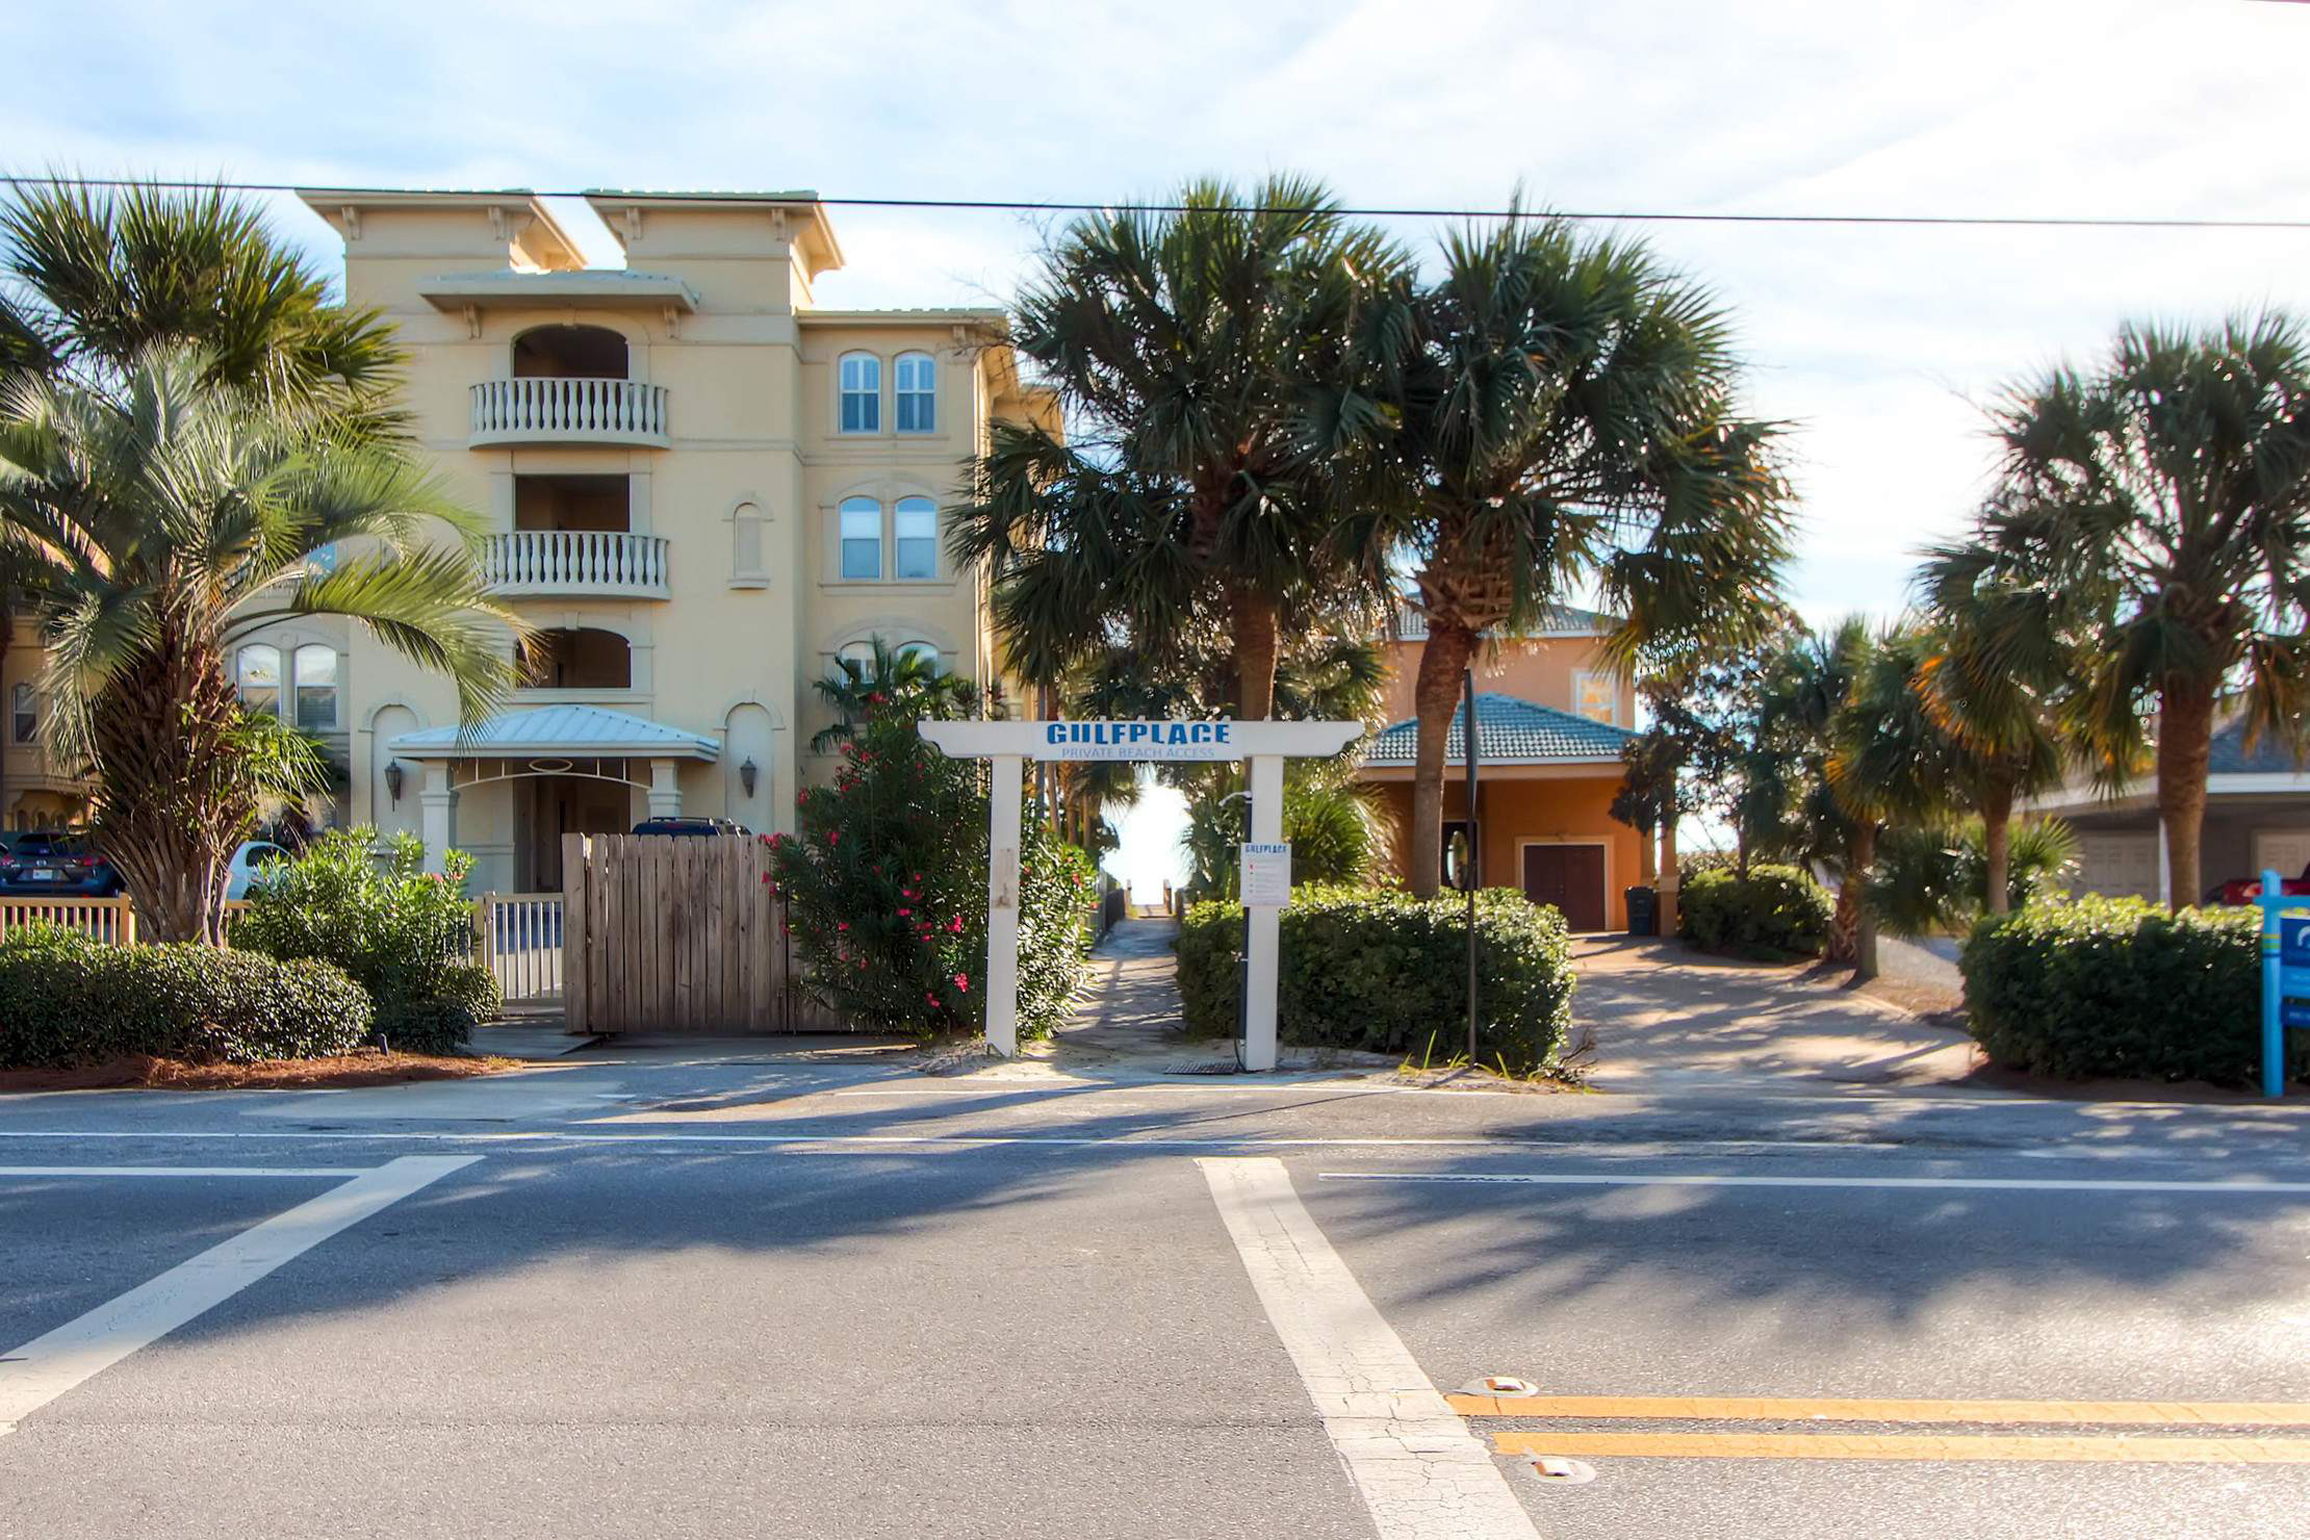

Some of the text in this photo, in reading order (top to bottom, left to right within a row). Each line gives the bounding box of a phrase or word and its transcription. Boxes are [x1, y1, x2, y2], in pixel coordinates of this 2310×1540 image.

[1047, 724, 1230, 744] GULFPLACE
[1062, 748, 1215, 759] PRIVATE BEACH ACCESS
